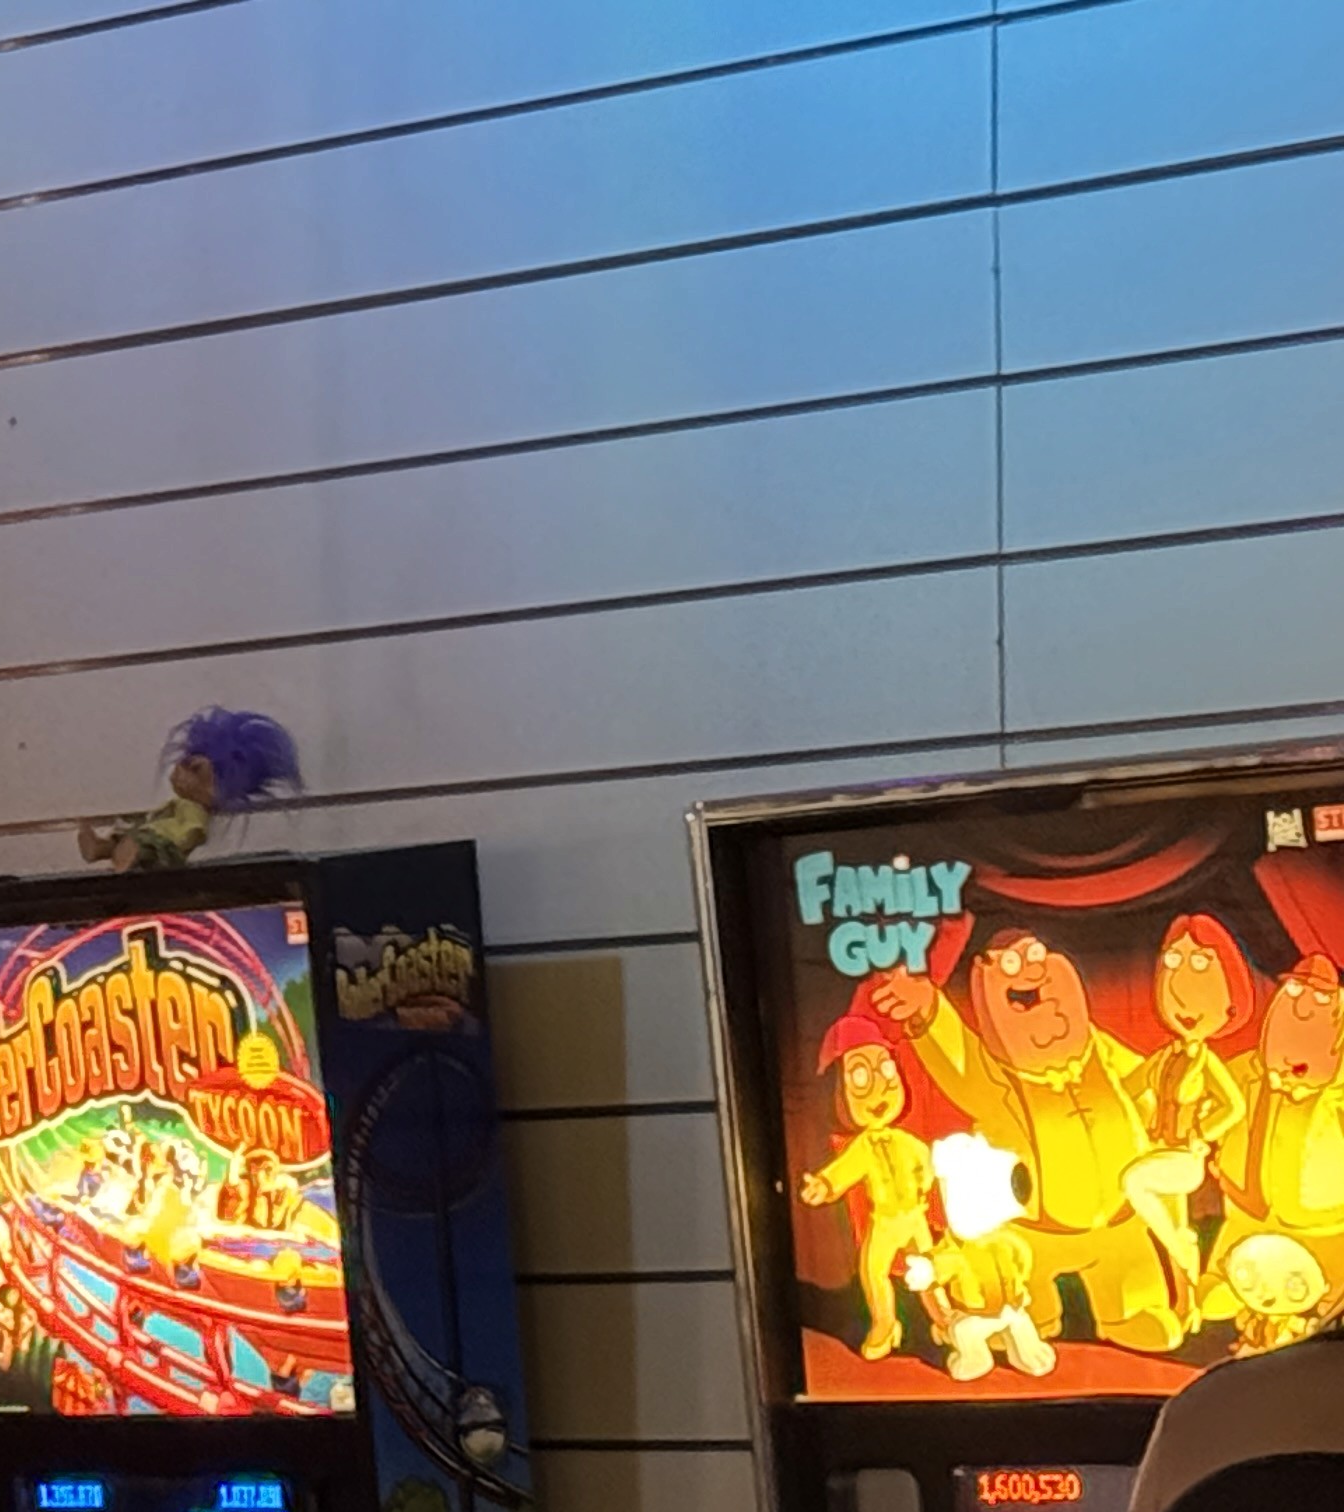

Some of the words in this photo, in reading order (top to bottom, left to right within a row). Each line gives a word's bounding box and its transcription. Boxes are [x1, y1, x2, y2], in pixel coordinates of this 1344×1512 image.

[828, 922, 936, 977] GUY
[189, 1089, 304, 1163] TYCOON
[978, 1473, 1082, 1505] 1,600,530
